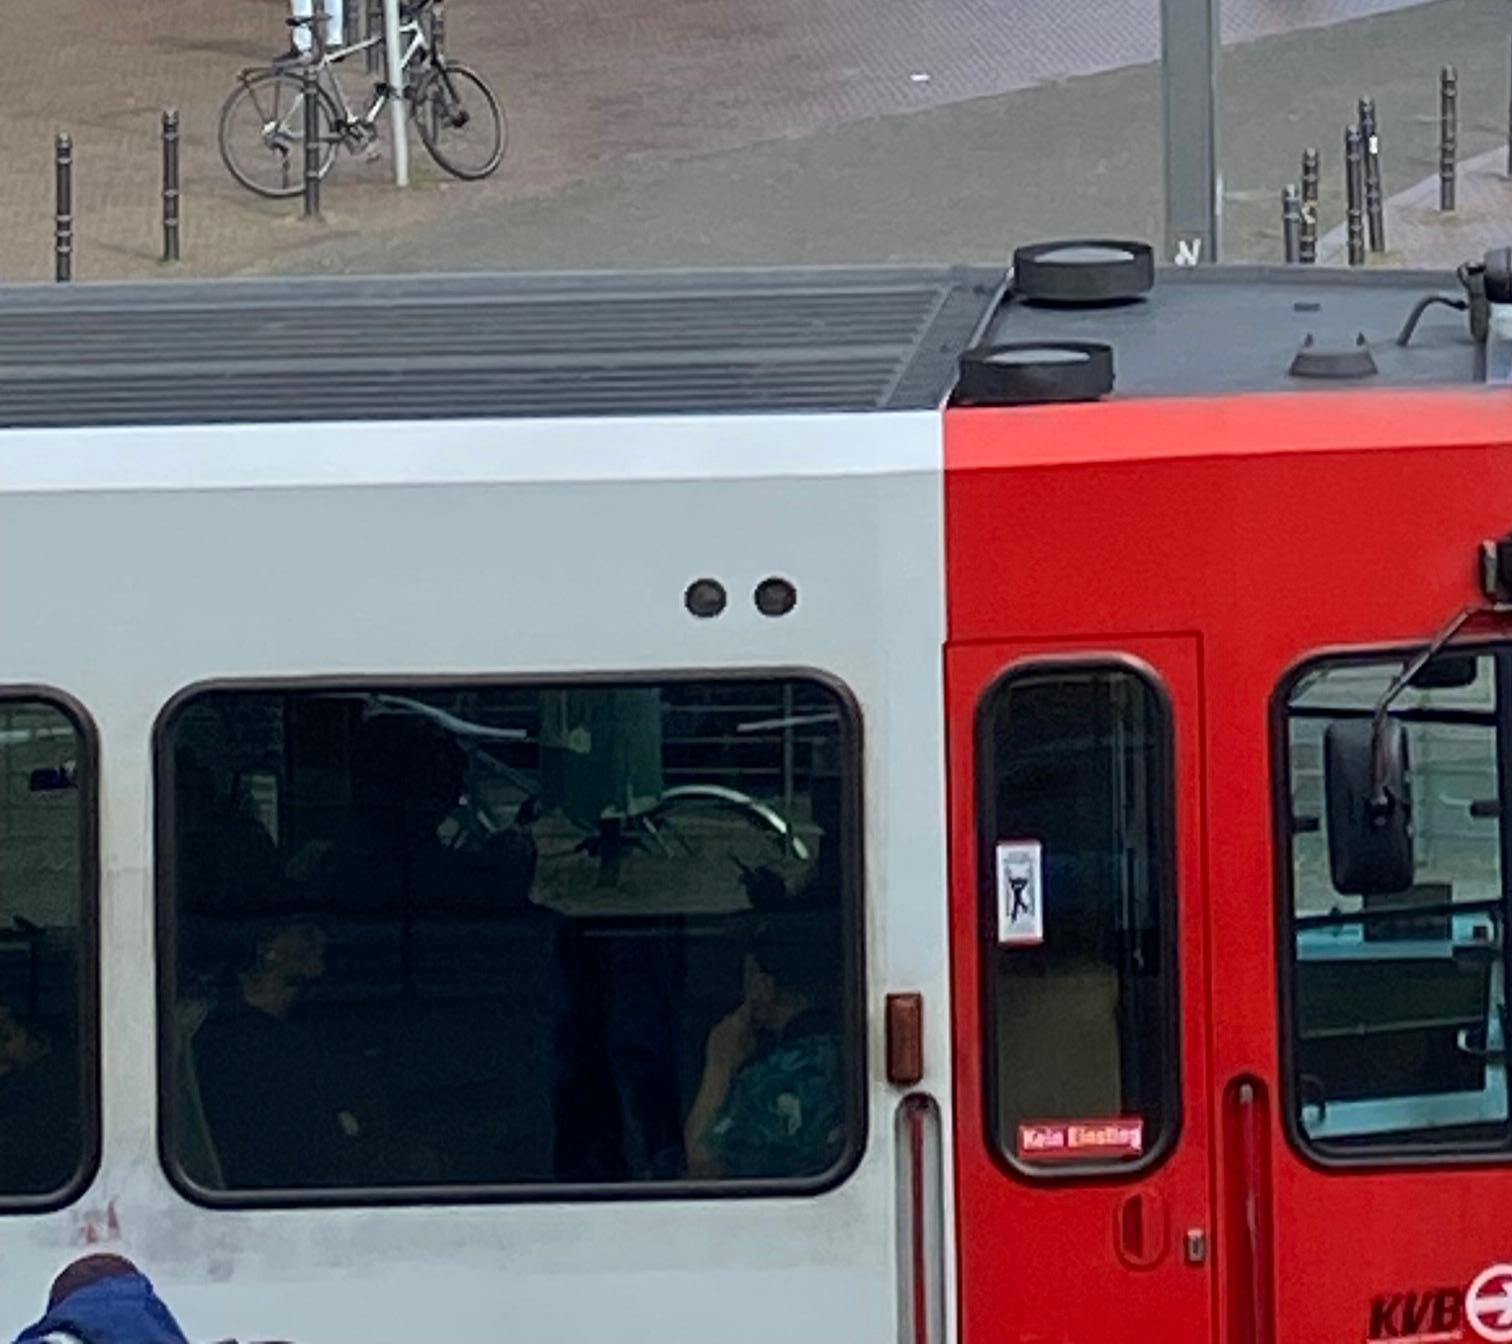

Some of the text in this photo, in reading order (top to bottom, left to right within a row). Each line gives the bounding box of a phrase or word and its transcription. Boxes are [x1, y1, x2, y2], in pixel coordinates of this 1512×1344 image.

[1023, 1124, 1141, 1150] Kein Einstieg
[1369, 1288, 1463, 1338] KVB
